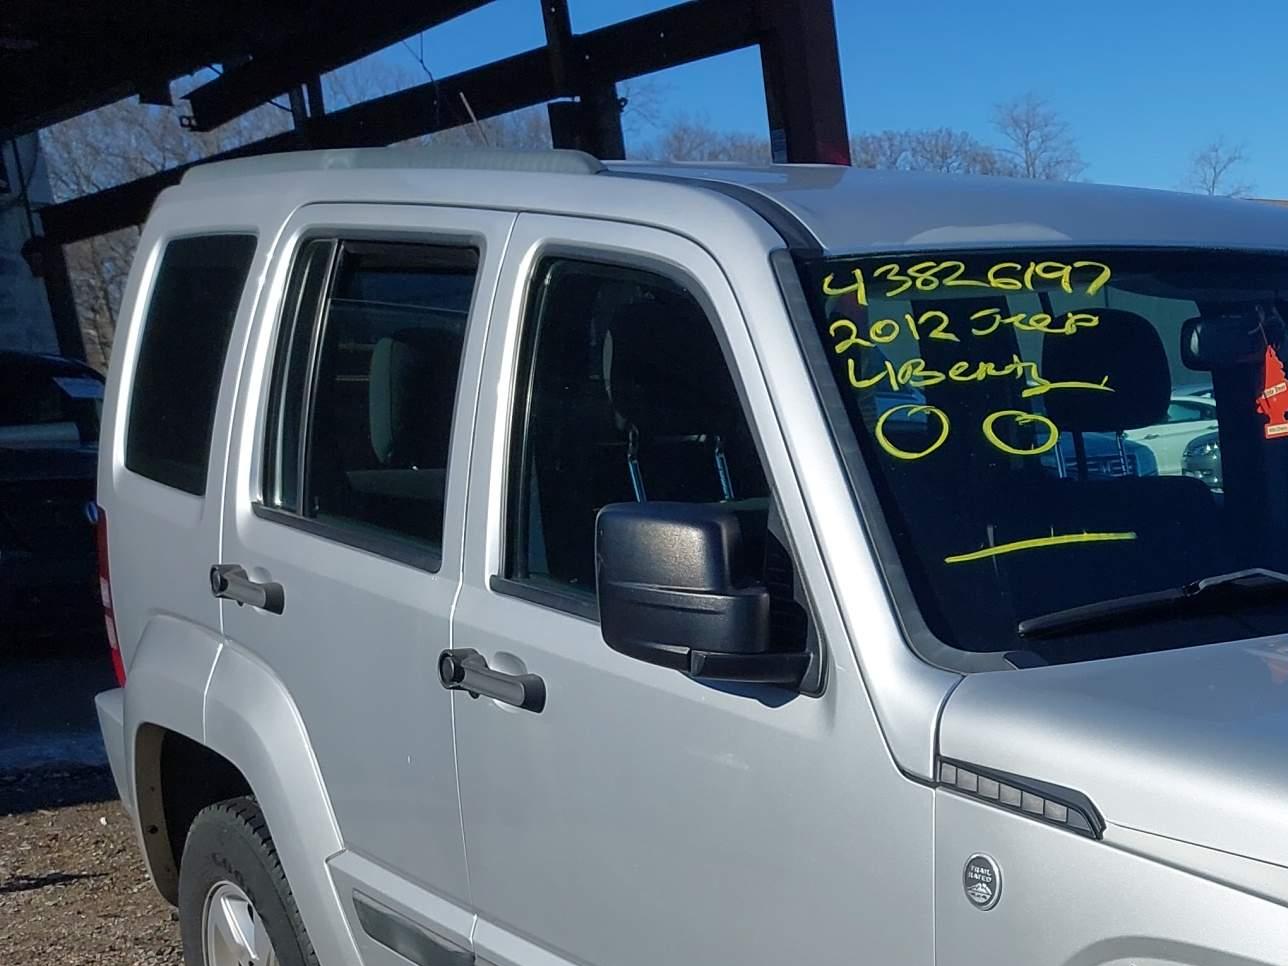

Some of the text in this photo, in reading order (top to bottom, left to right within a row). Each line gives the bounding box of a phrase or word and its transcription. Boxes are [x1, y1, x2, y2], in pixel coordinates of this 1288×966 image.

[823, 261, 1112, 306] 43826197
[828, 310, 961, 354] 2012
[970, 865, 992, 876] TRAIL
